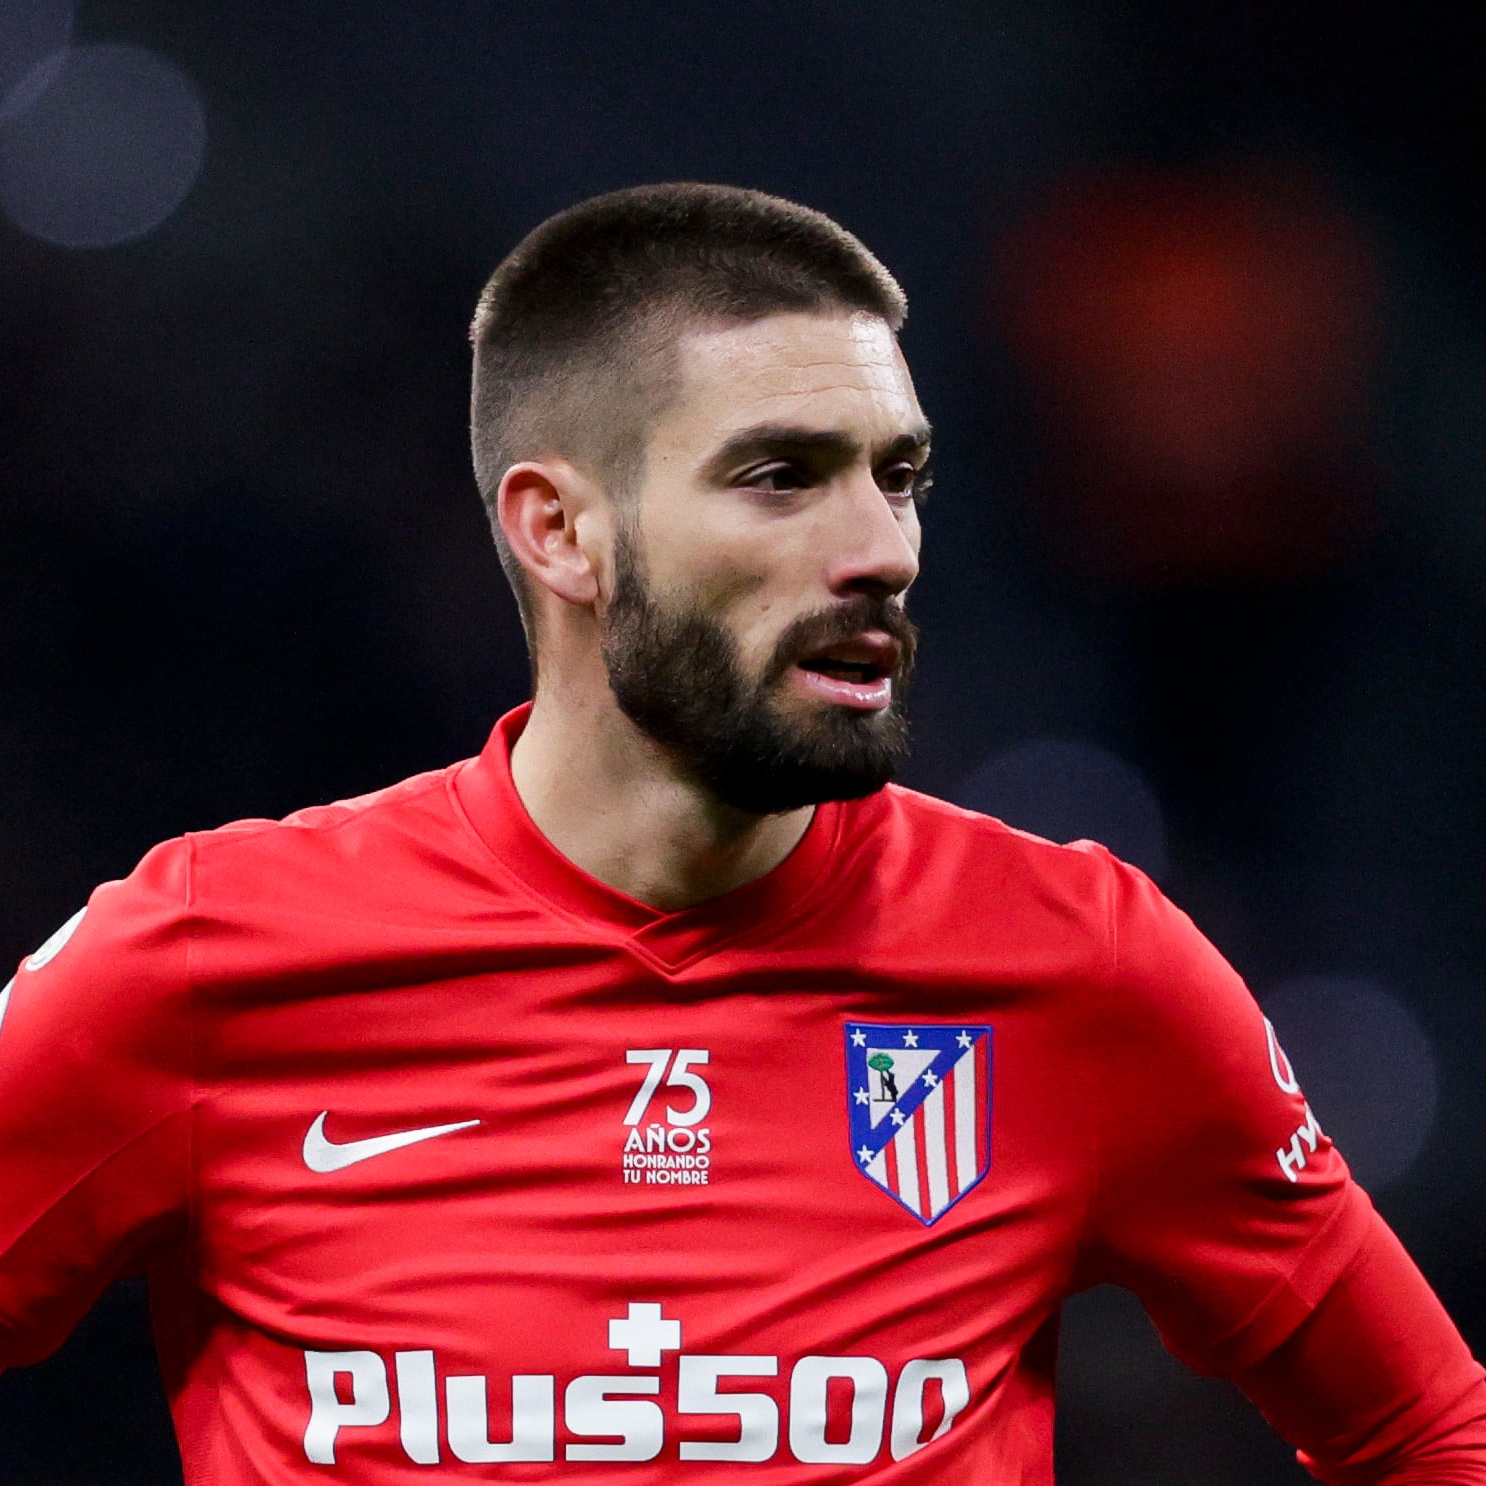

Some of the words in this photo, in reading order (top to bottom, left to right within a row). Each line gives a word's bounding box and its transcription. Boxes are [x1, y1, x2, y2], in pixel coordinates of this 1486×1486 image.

[623, 1049, 711, 1127] 75
[624, 1123, 711, 1154] AÑOS
[623, 1154, 710, 1169] HONRANDO
[623, 1169, 641, 1184] TU
[646, 1170, 709, 1185] NOMBRE
[303, 1348, 970, 1465] Plus500
